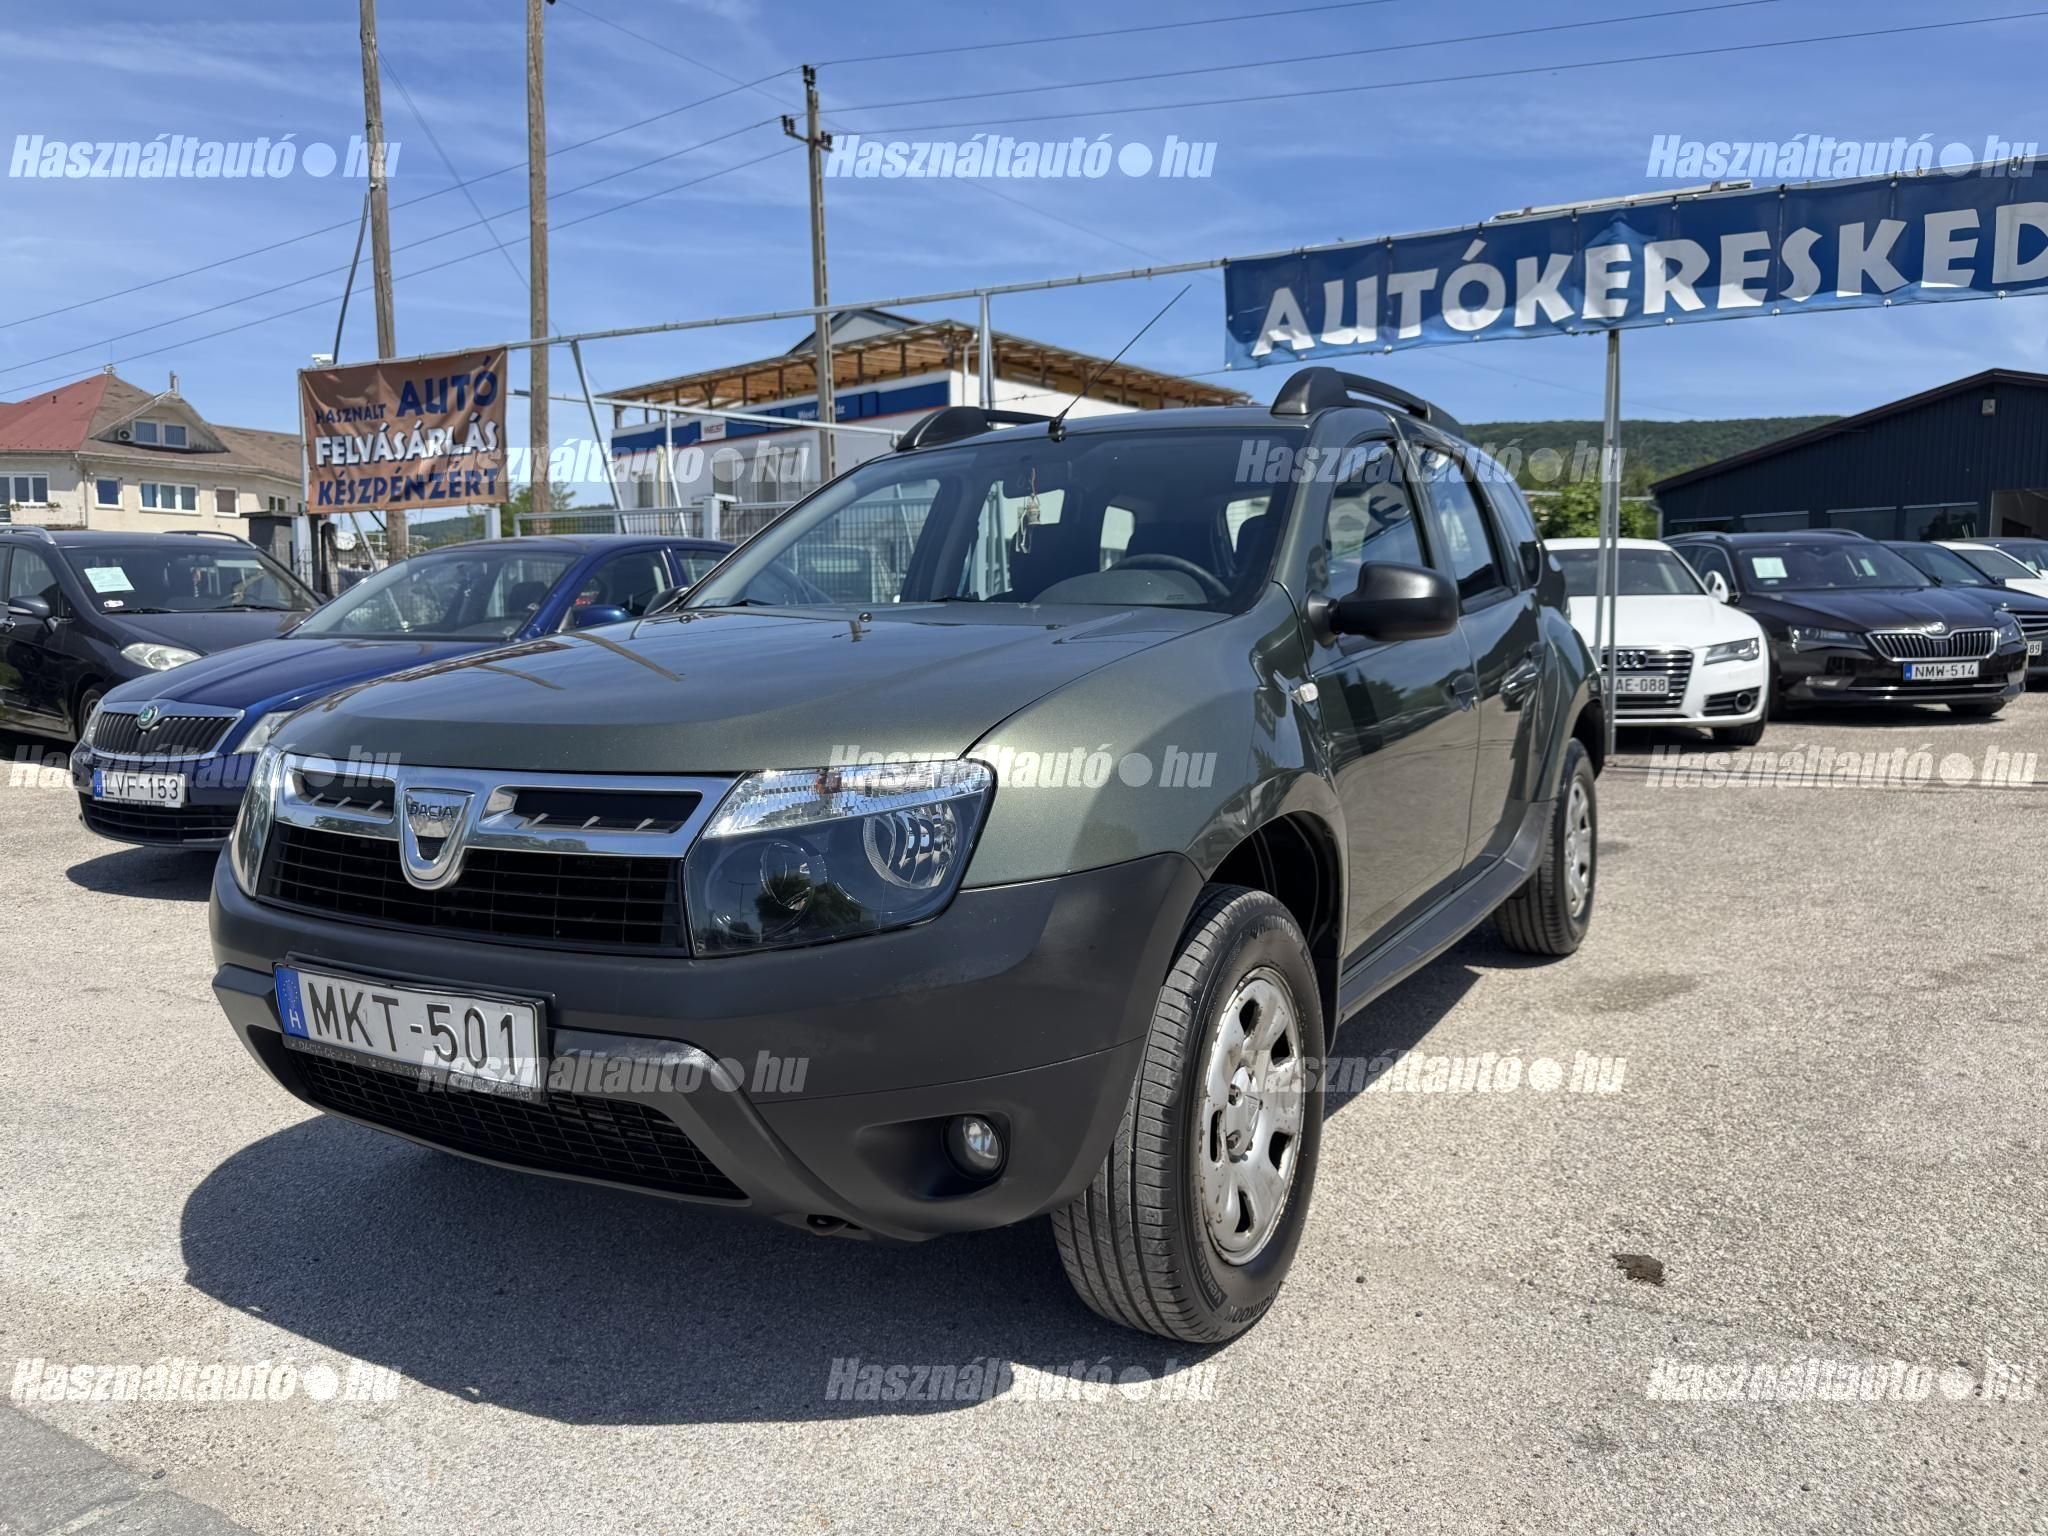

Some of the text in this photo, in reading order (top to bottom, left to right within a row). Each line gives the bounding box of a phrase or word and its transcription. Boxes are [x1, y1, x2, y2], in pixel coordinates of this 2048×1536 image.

[1251, 201, 2048, 358] AUTÓKERESKED
[315, 356, 498, 425] HASZNÁLT AUTÓ
[315, 412, 499, 467] FELVÁSÁRLÁS
[317, 461, 500, 506] KÉSZPÉNZÉRT
[1915, 664, 1975, 678] NMW-514
[104, 774, 178, 800] LVF-153
[408, 803, 453, 818] DACIA
[308, 982, 518, 1076] MKT-501
